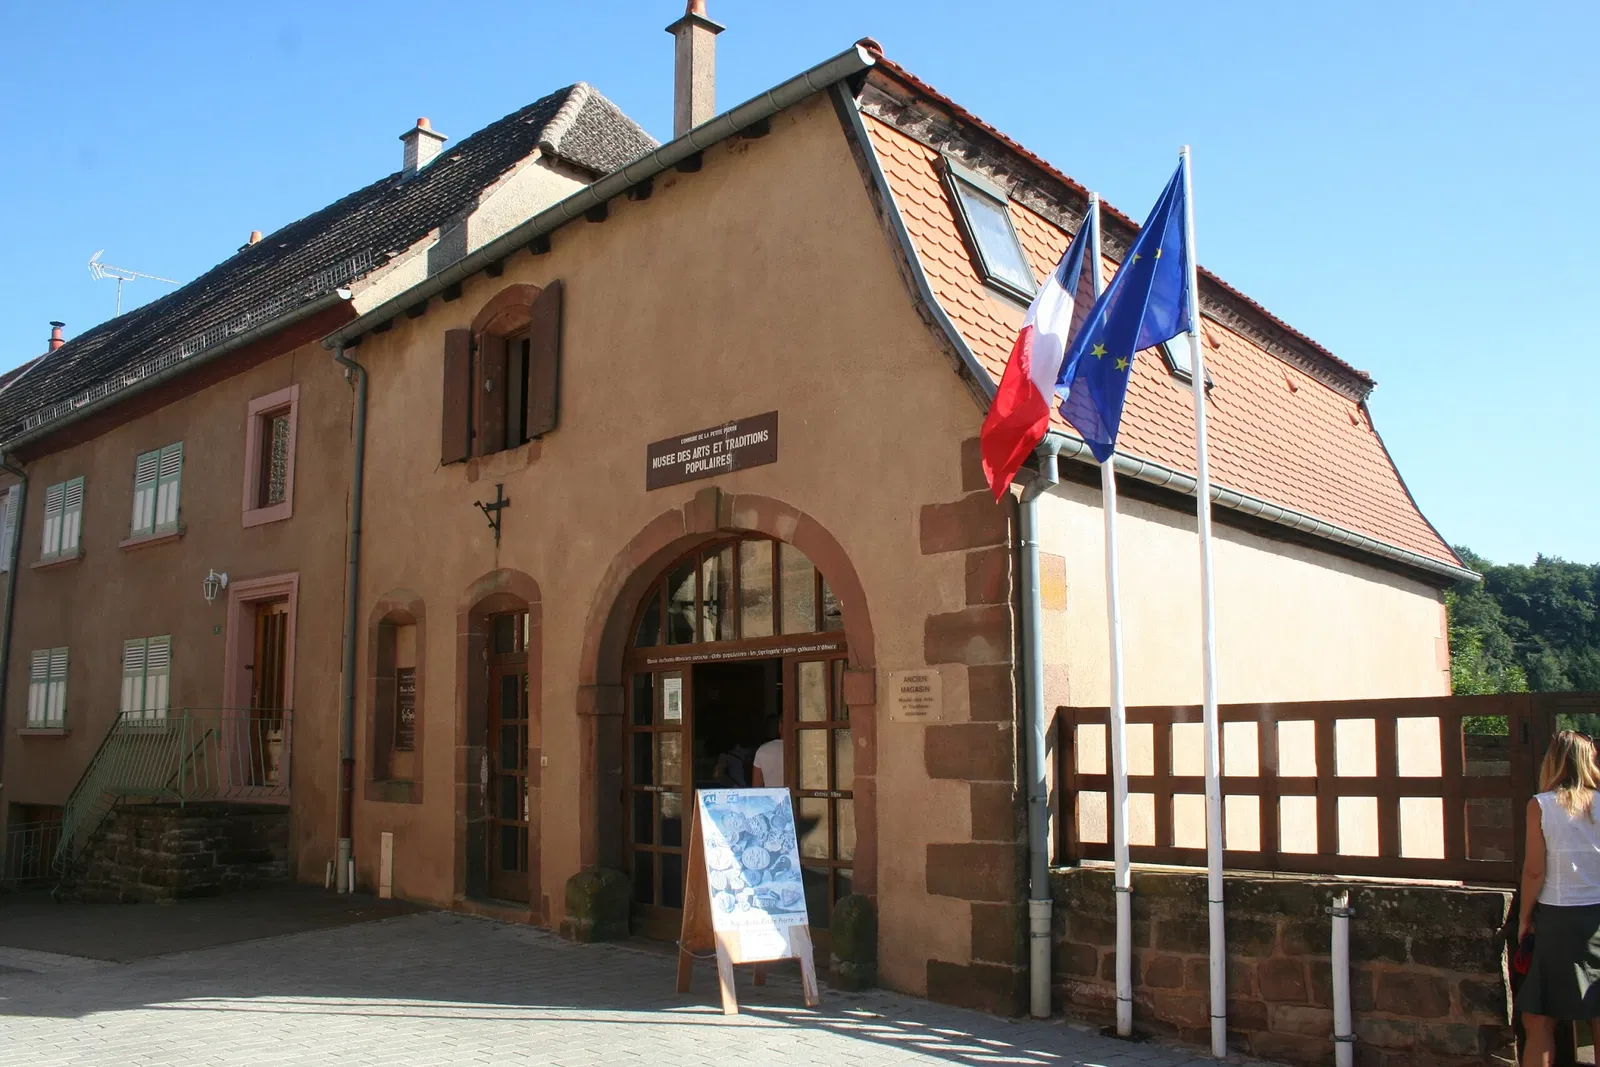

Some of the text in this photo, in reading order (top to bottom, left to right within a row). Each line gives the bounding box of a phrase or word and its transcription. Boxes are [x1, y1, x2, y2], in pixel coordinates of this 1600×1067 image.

[652, 429, 769, 469] MUSEE DES ARTS ET TRADITIONS
[685, 453, 731, 475] POPULAIRES
[903, 675, 927, 683] ANCIEN
